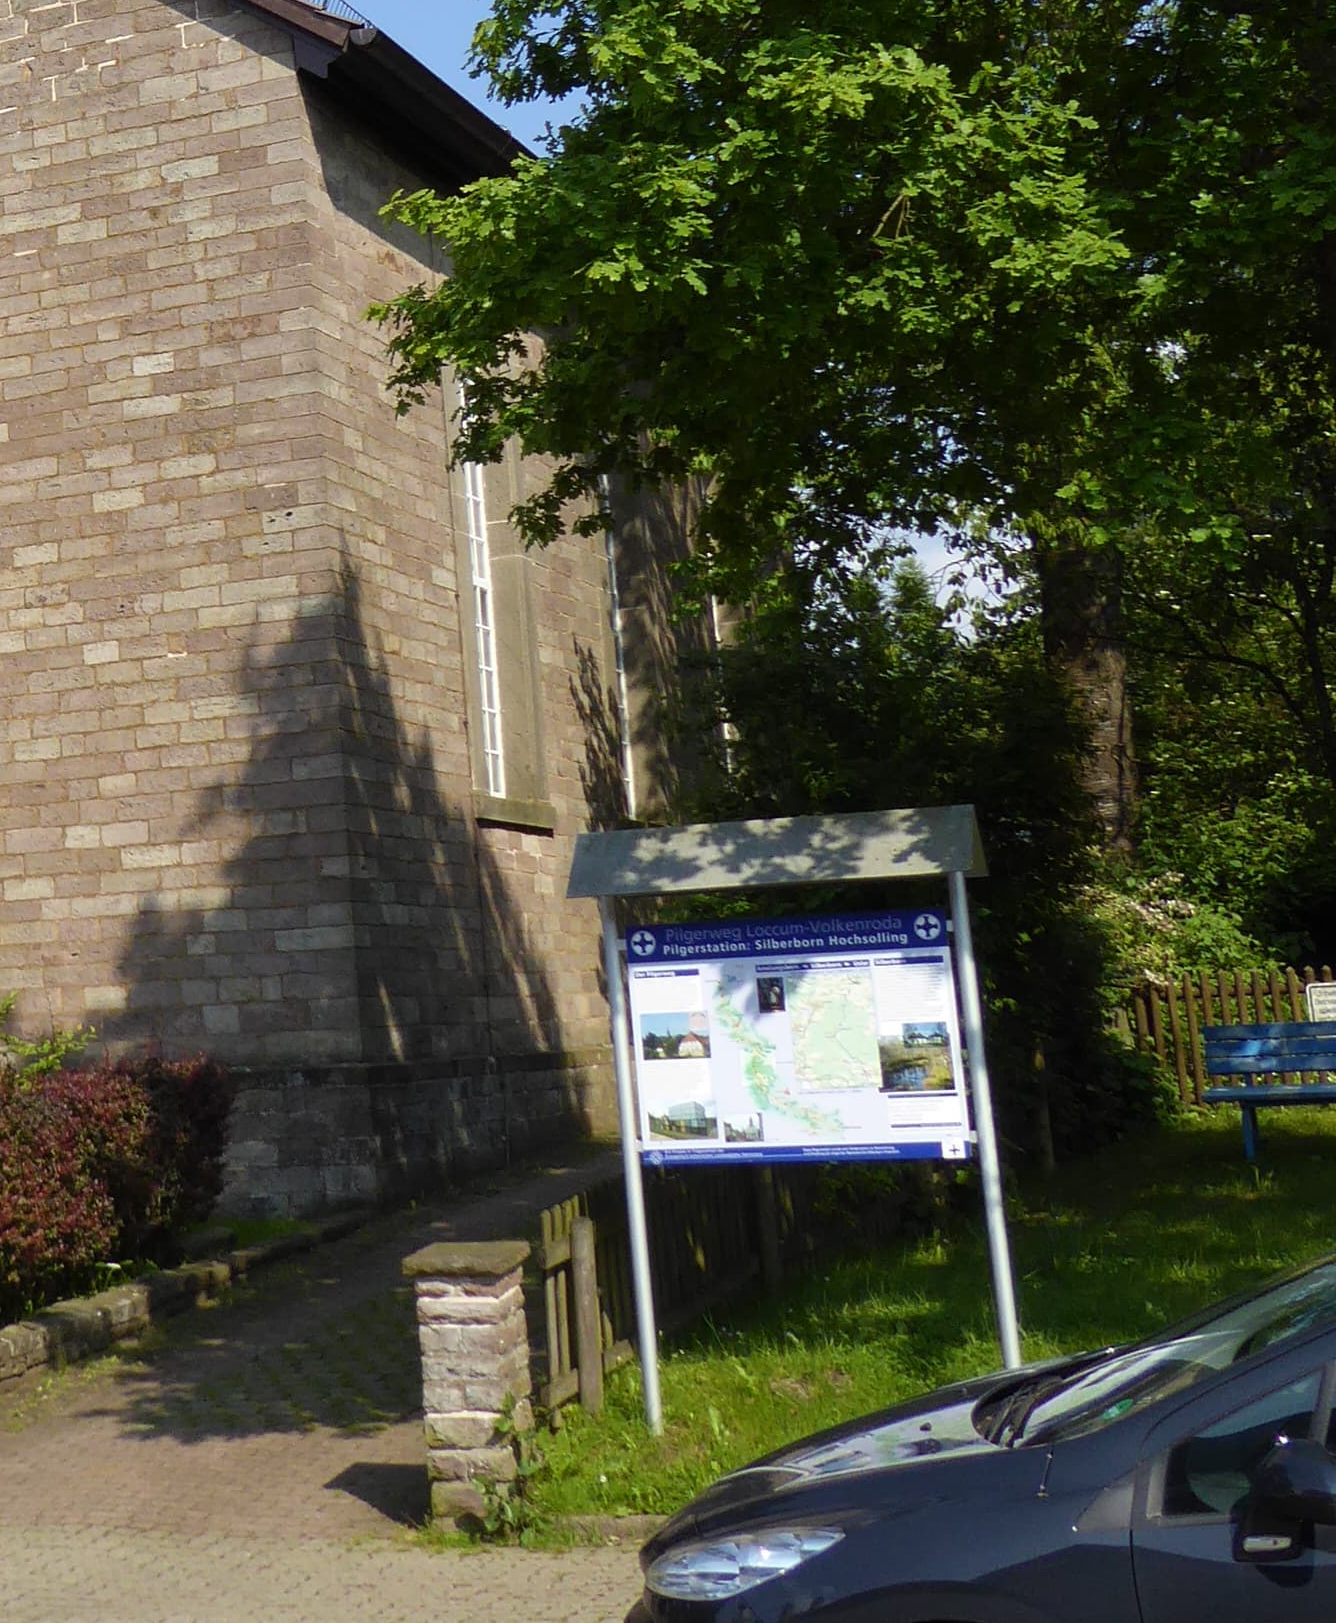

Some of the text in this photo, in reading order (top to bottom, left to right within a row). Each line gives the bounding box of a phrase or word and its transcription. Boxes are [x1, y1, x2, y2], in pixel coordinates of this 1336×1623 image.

[663, 931, 908, 957] Pilgerstation: Silberborn Hochsolling
[665, 916, 903, 945] Pilgerweg Loccum-Volkenroda
